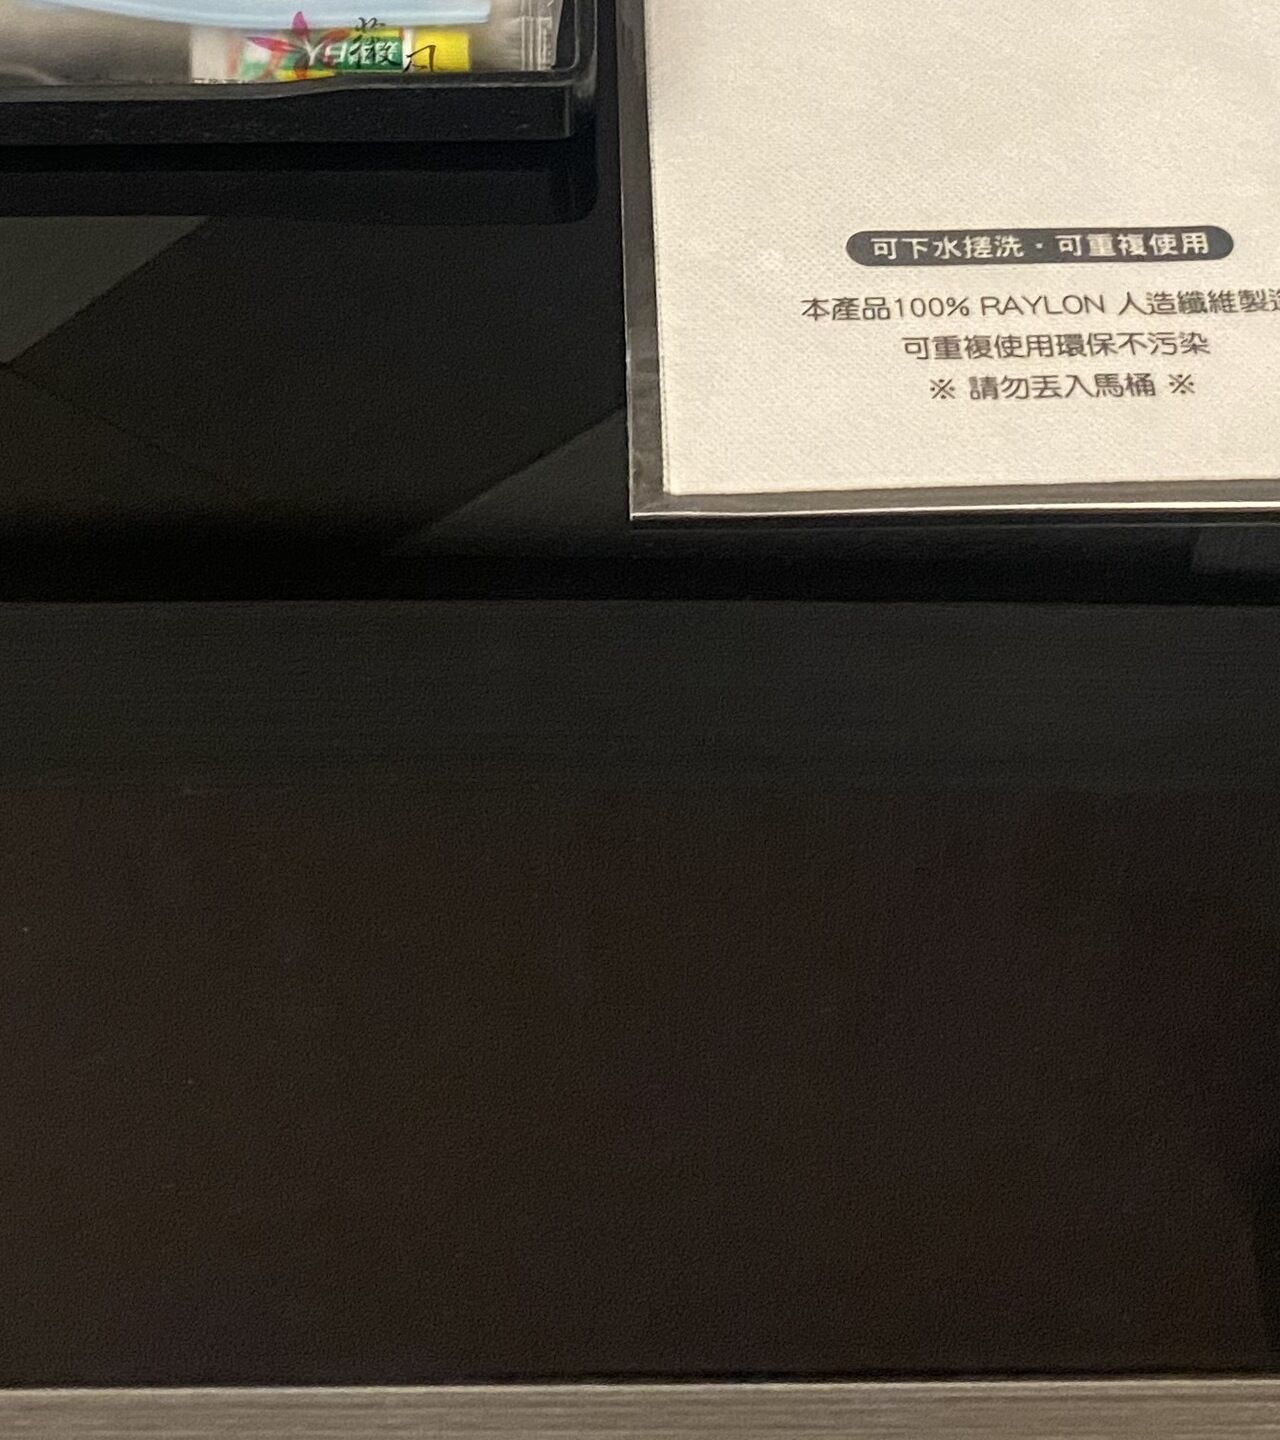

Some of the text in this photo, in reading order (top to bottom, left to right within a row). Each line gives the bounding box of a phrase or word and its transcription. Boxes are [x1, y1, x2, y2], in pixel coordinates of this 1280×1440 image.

[801, 296, 969, 322] 本產品100%
[981, 294, 1105, 317] RAYLON
